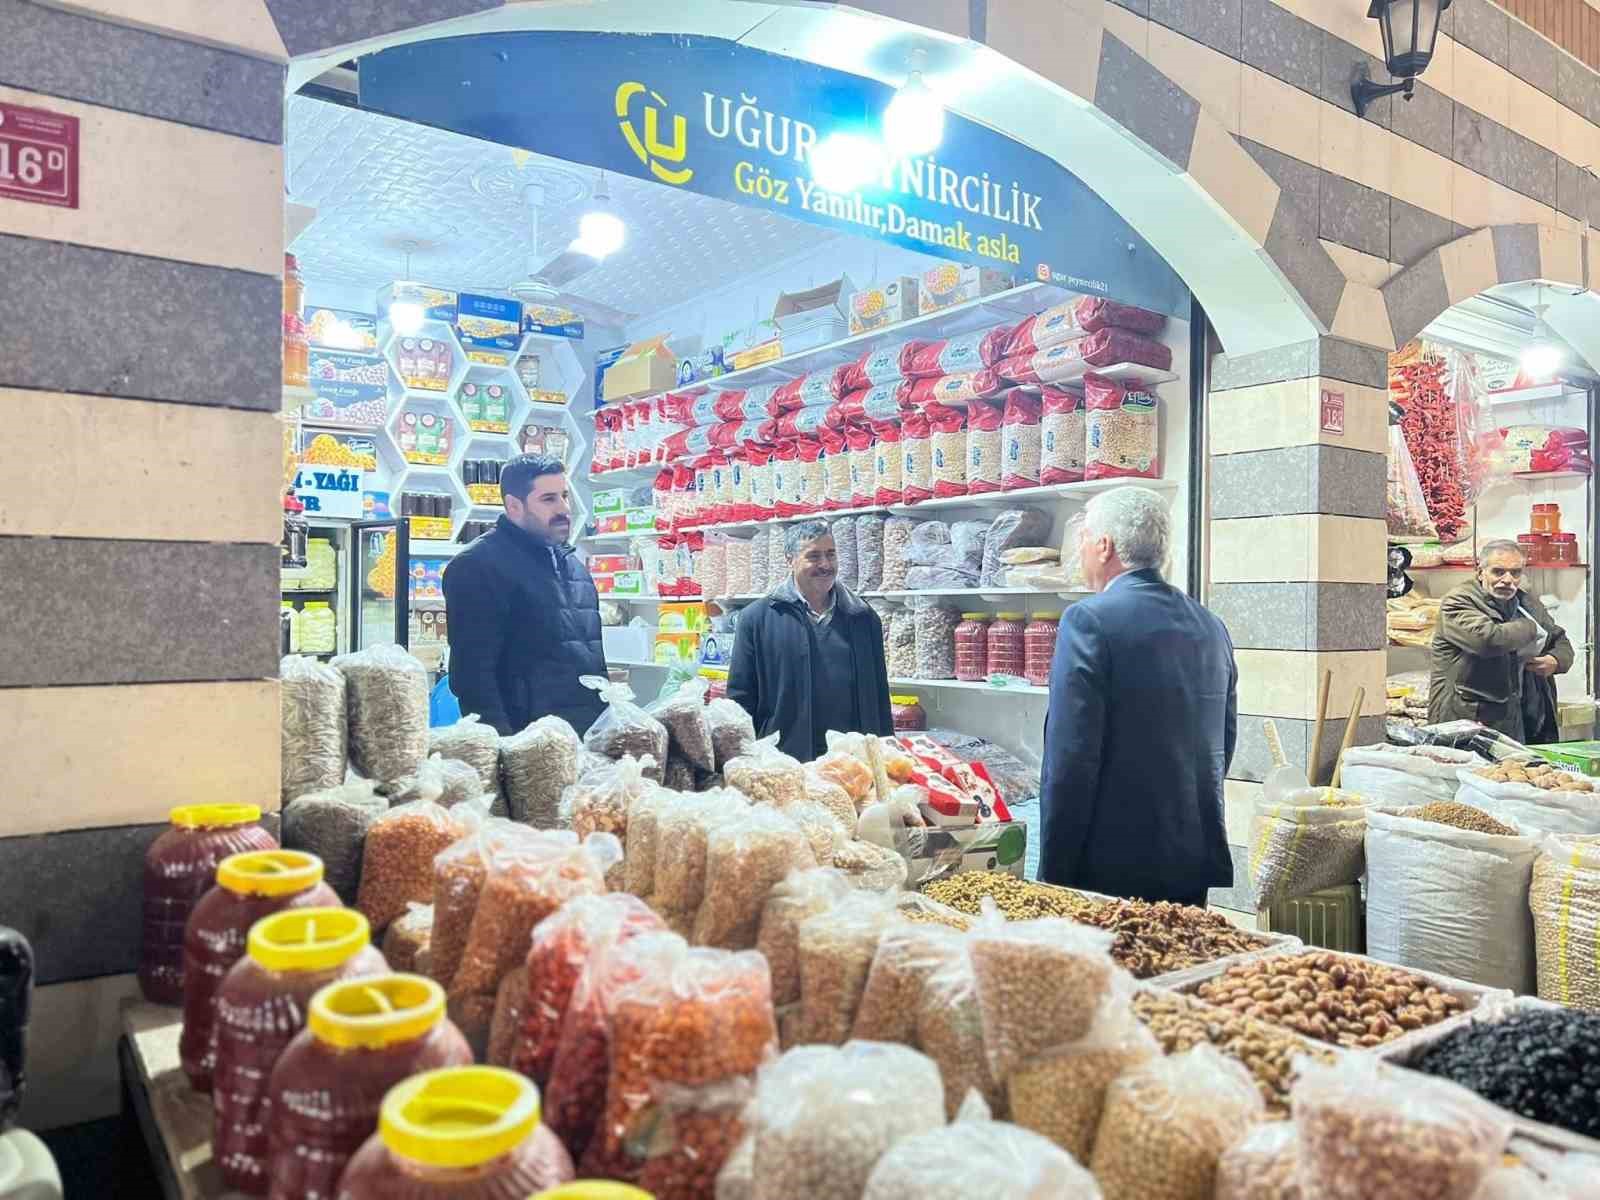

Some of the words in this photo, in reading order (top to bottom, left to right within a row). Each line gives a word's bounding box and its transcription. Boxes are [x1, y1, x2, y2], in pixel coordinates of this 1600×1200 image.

[702, 91, 817, 164] UĞUR
[734, 161, 789, 205] Göz
[976, 232, 1020, 264] asla
